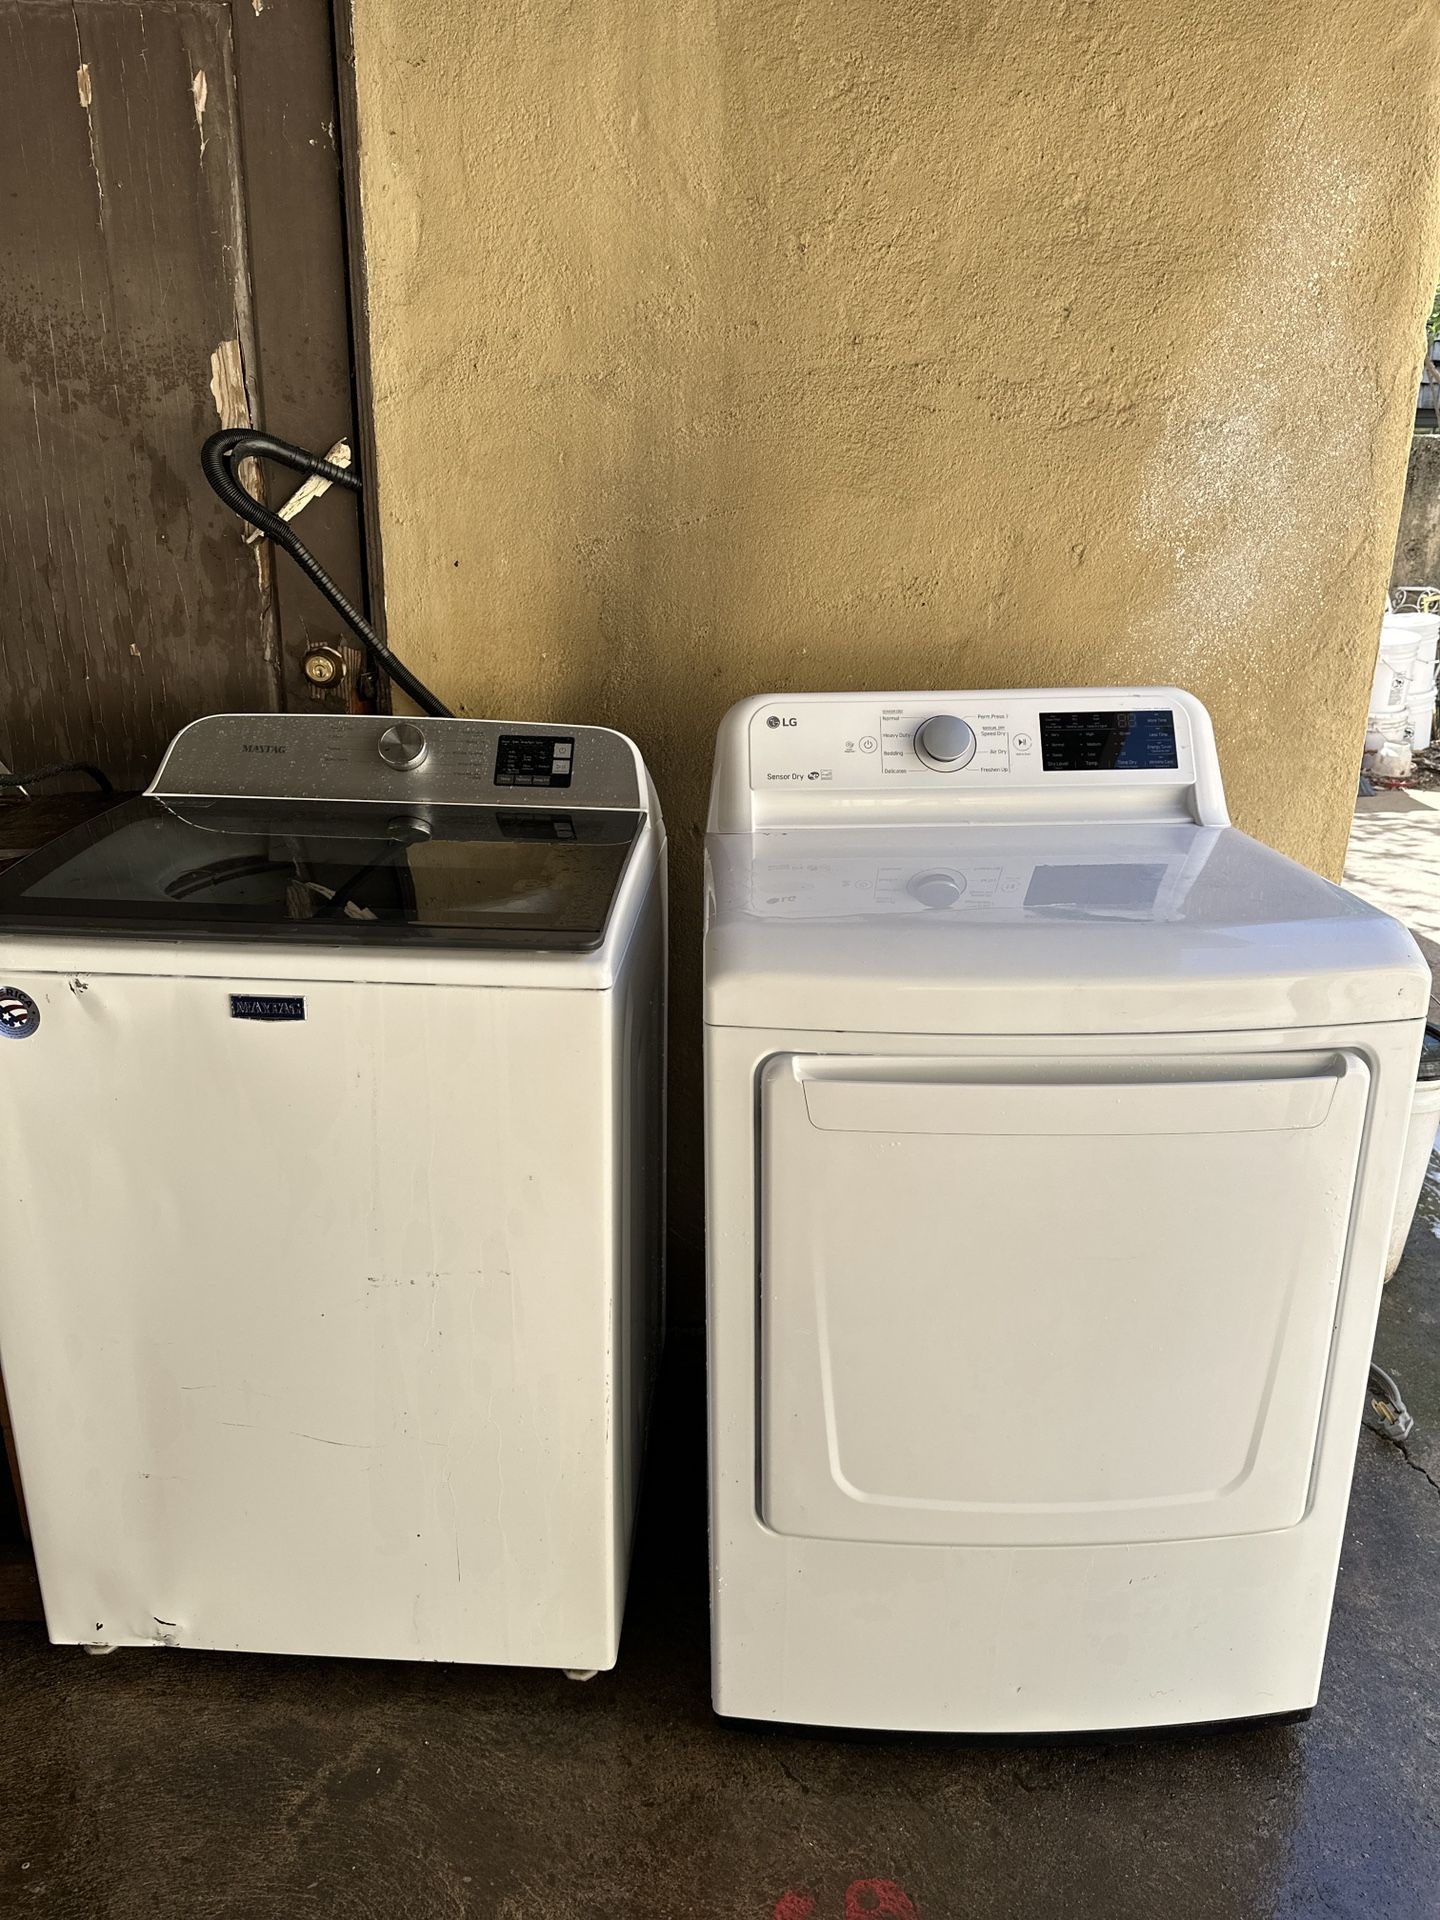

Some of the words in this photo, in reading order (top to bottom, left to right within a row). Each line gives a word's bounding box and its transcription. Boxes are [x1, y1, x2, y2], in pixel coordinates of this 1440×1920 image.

[782, 717, 798, 727] LG
[241, 744, 287, 754] MAYTAG
[792, 773, 804, 781] Dry
[236, 1001, 302, 1015] MAYTAG
